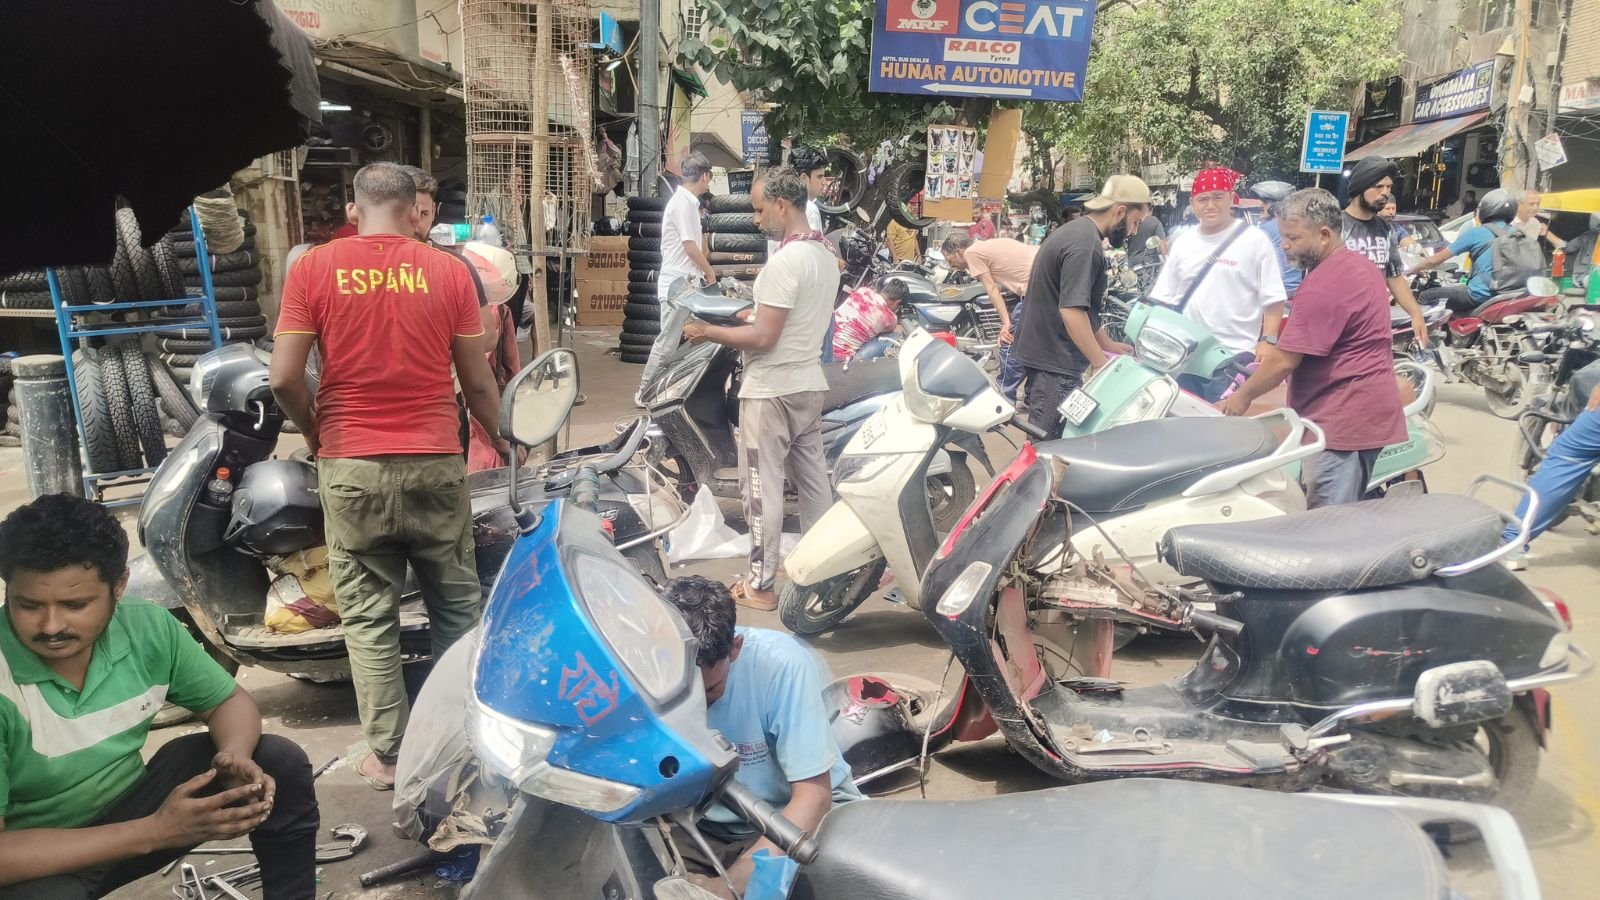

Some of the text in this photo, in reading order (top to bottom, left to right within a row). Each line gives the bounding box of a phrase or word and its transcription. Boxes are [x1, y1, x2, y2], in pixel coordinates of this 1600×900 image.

[897, 19, 949, 31] MRF
[965, 1, 1084, 37] CEAT
[948, 40, 1017, 54] RALCO
[990, 55, 1011, 63] Tyres
[880, 62, 1076, 88] HUNAR AUTOMOTIVE
[1415, 86, 1489, 119] CAR ACCESSORIES
[588, 252, 626, 269] STUDDS
[336, 262, 429, 295] ESPAÑA
